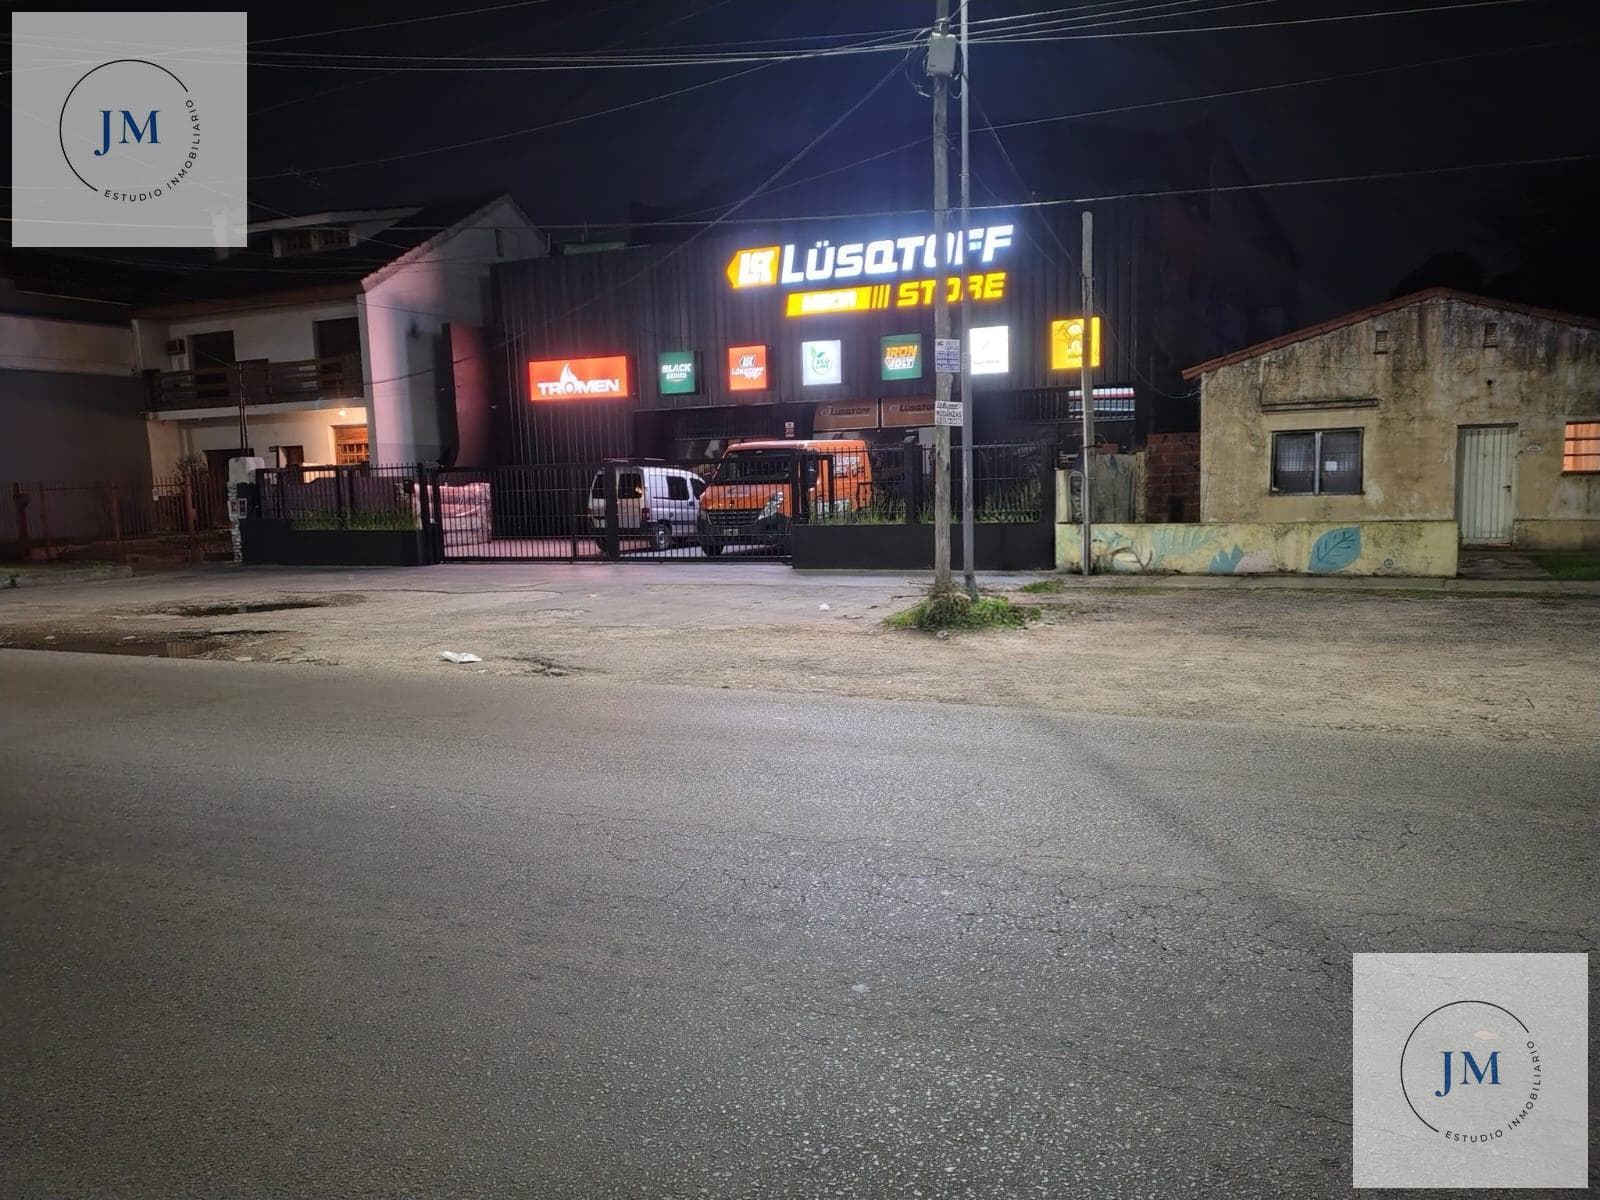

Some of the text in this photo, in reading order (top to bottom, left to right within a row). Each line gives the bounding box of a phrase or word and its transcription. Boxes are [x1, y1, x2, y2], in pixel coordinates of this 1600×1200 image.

[897, 272, 1006, 307] STORE
[661, 362, 692, 374] BLACK
[537, 378, 620, 396] TROMEN
